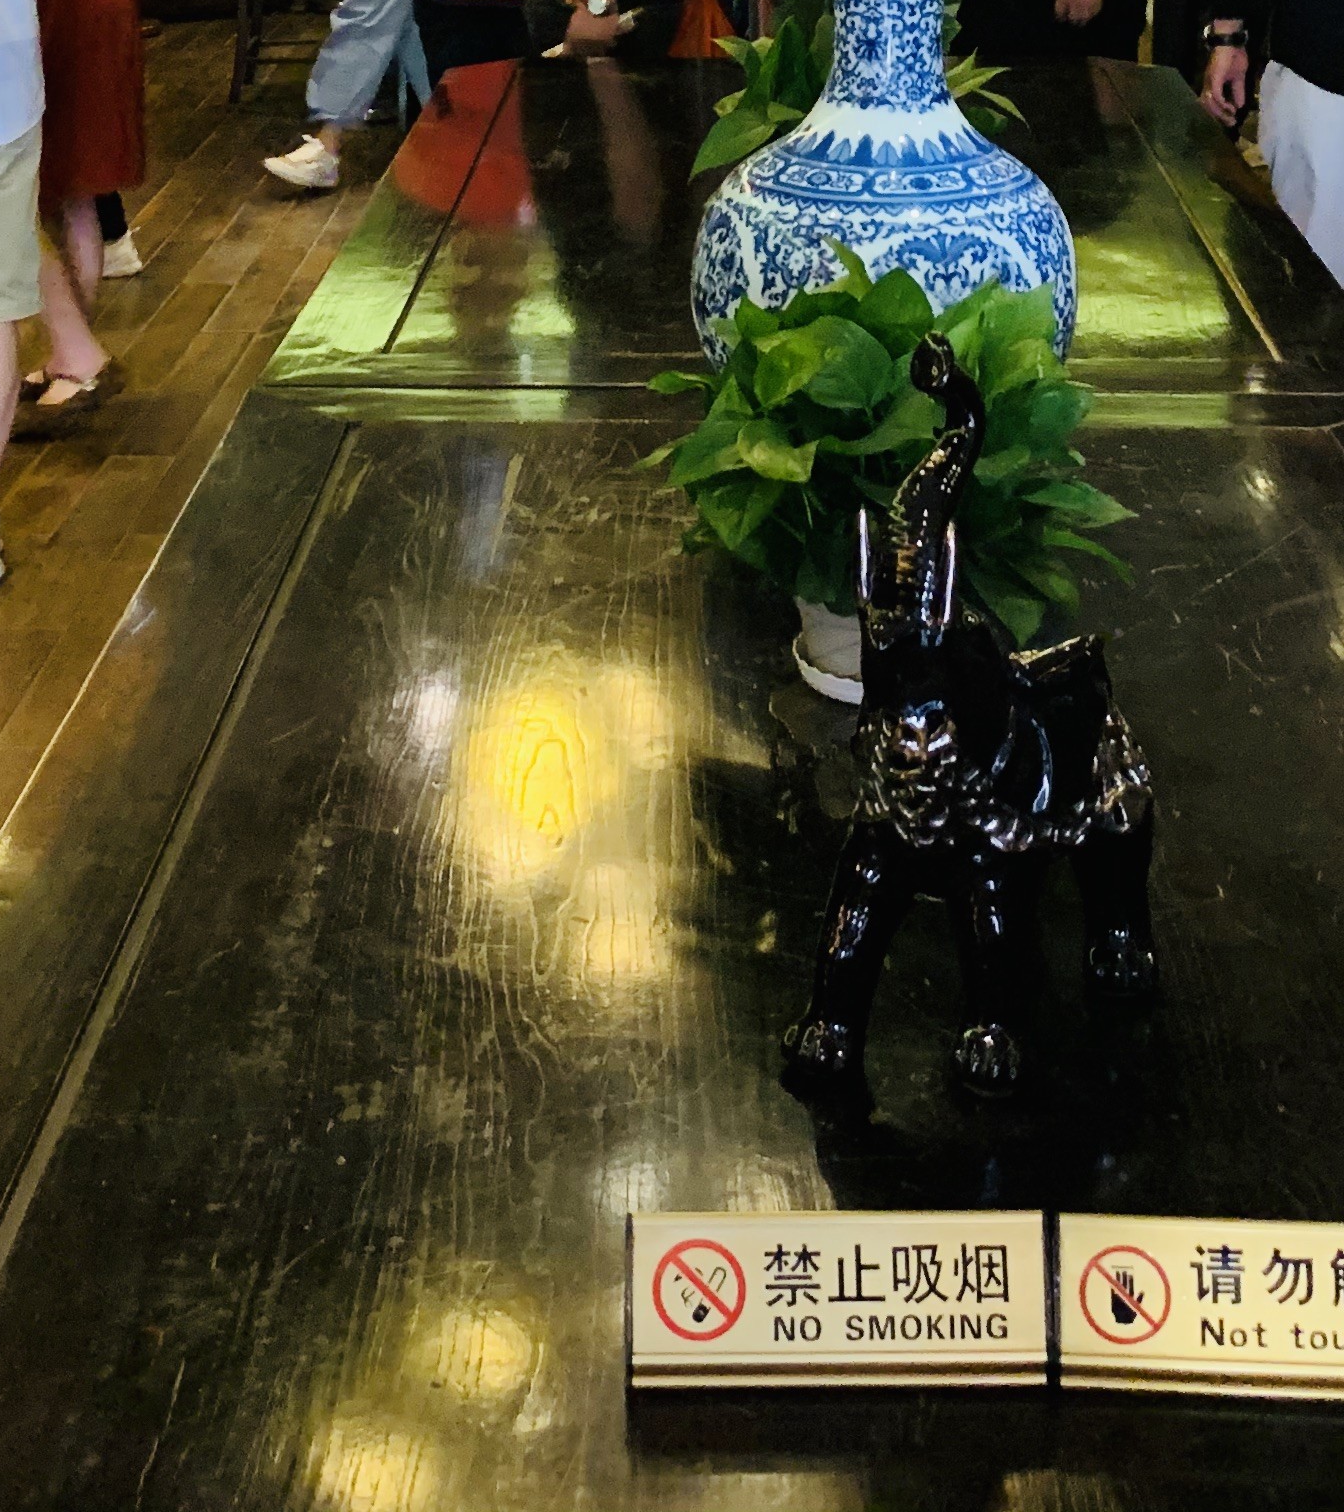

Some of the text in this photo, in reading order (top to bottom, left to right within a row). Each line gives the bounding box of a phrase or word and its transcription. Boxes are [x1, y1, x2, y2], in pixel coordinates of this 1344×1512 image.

[763, 1242, 1010, 1307] 禁止吸烟
[772, 1313, 1010, 1342] NO SMOKING
[1200, 1317, 1268, 1348] Not
